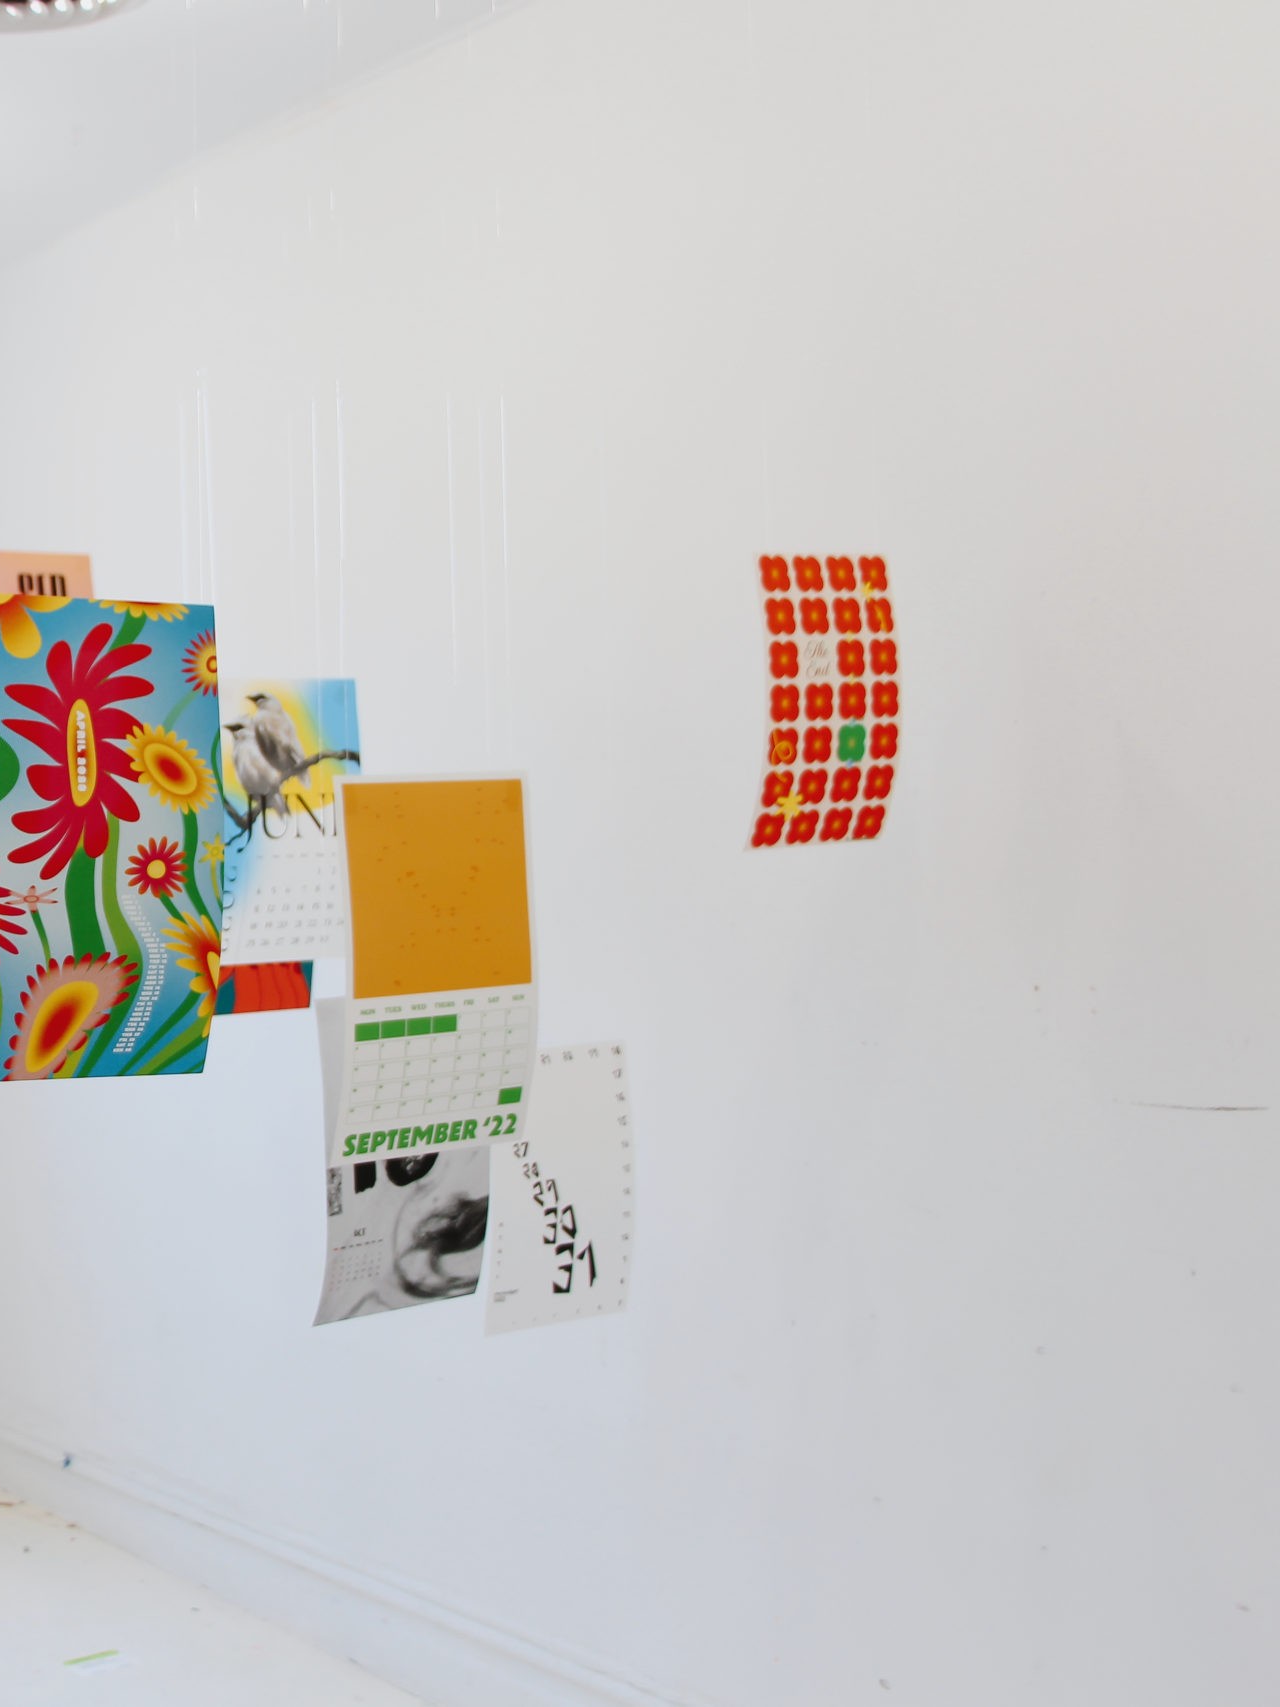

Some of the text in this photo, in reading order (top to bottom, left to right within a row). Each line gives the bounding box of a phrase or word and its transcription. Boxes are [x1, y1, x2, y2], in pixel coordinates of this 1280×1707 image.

[76, 710, 86, 753] APRIL
[342, 1118, 478, 1157] SEPTEMBER
[513, 1141, 529, 1158] 27
[552, 1240, 597, 1294] 31
